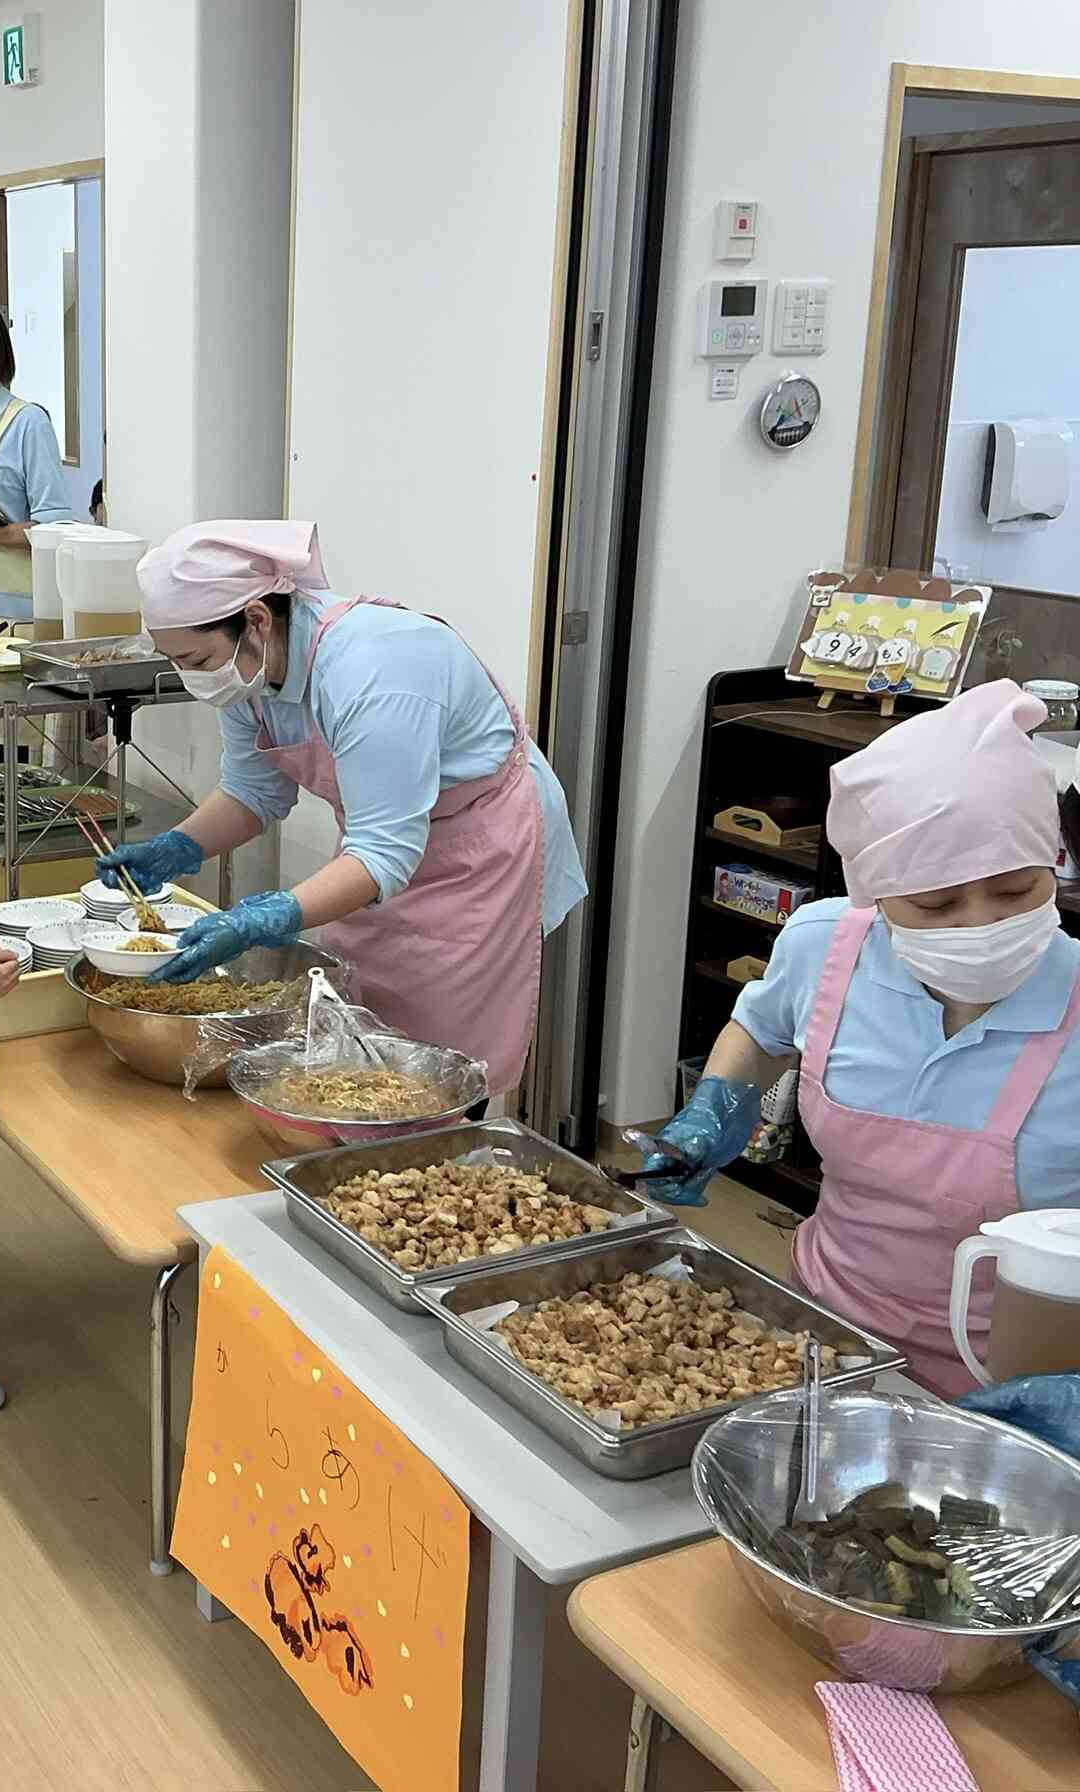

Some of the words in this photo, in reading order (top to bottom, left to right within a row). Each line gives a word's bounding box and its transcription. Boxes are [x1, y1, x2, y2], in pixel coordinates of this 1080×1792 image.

[829, 639, 841, 653] 9
[848, 646, 863, 658] 4
[881, 647, 904, 659] もく
